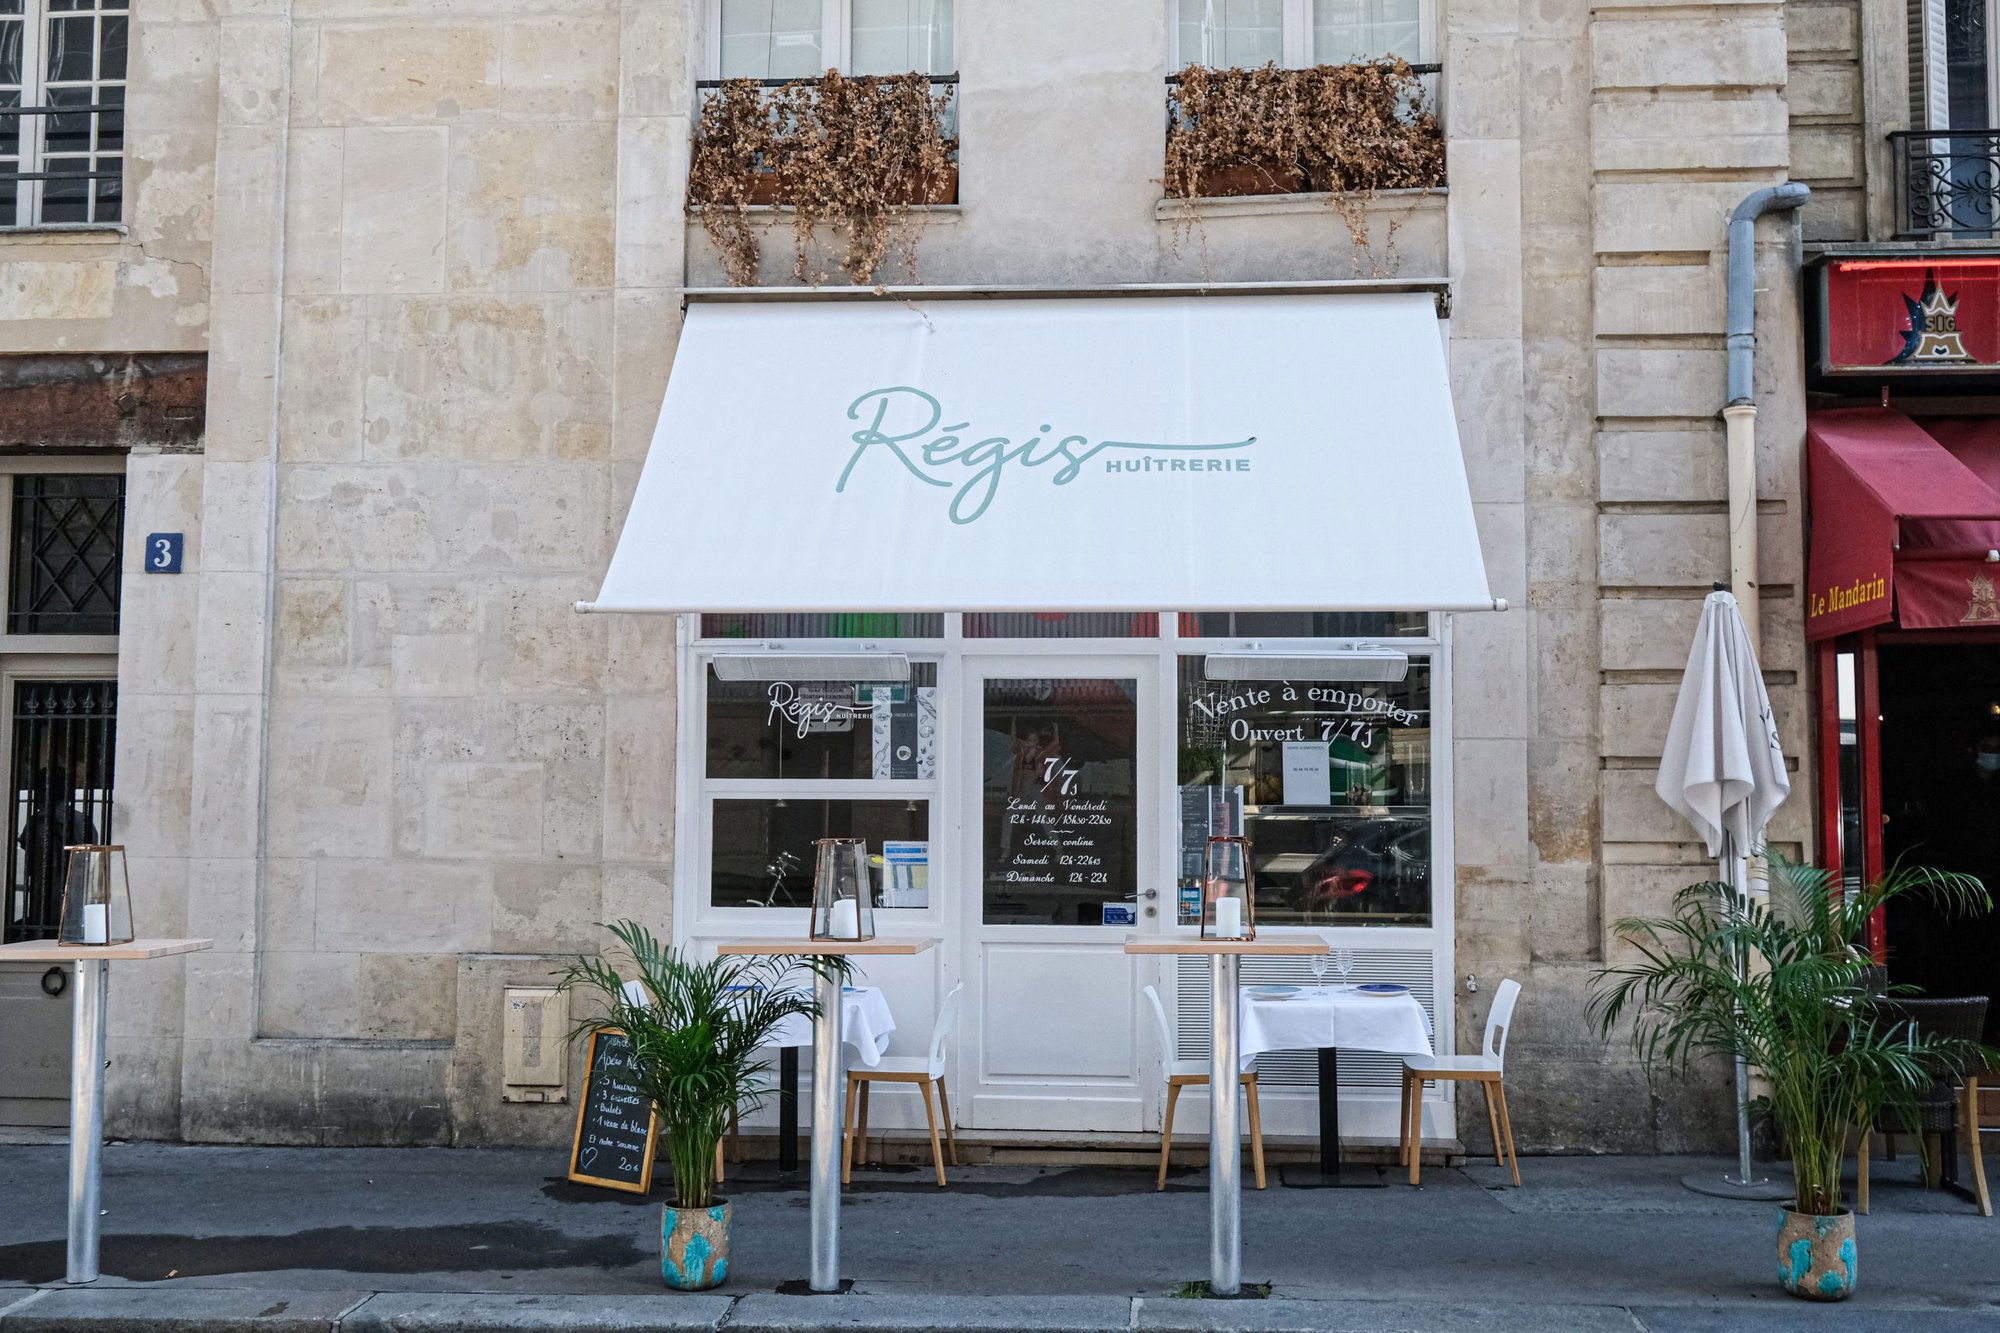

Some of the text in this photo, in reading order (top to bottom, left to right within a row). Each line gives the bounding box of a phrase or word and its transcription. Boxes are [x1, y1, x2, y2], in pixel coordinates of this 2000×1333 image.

[836, 386, 1257, 525] Régis HUÎTRERIE
[154, 539, 172, 568] 3
[1811, 573, 1885, 618] Le Mandarin
[767, 682, 873, 739] Régis
[1193, 680, 1418, 727] Vente à emporter
[1230, 719, 1305, 741] Ouvert
[1006, 796, 1037, 810] Lundi
[1063, 799, 1107, 811] Vendredi
[1024, 832, 1094, 846] Service continu
[1013, 853, 1049, 865] Samedi
[1006, 870, 1055, 883] Dimanche
[600, 1102, 622, 1115] Bulots
[620, 1120, 628, 1130] de
